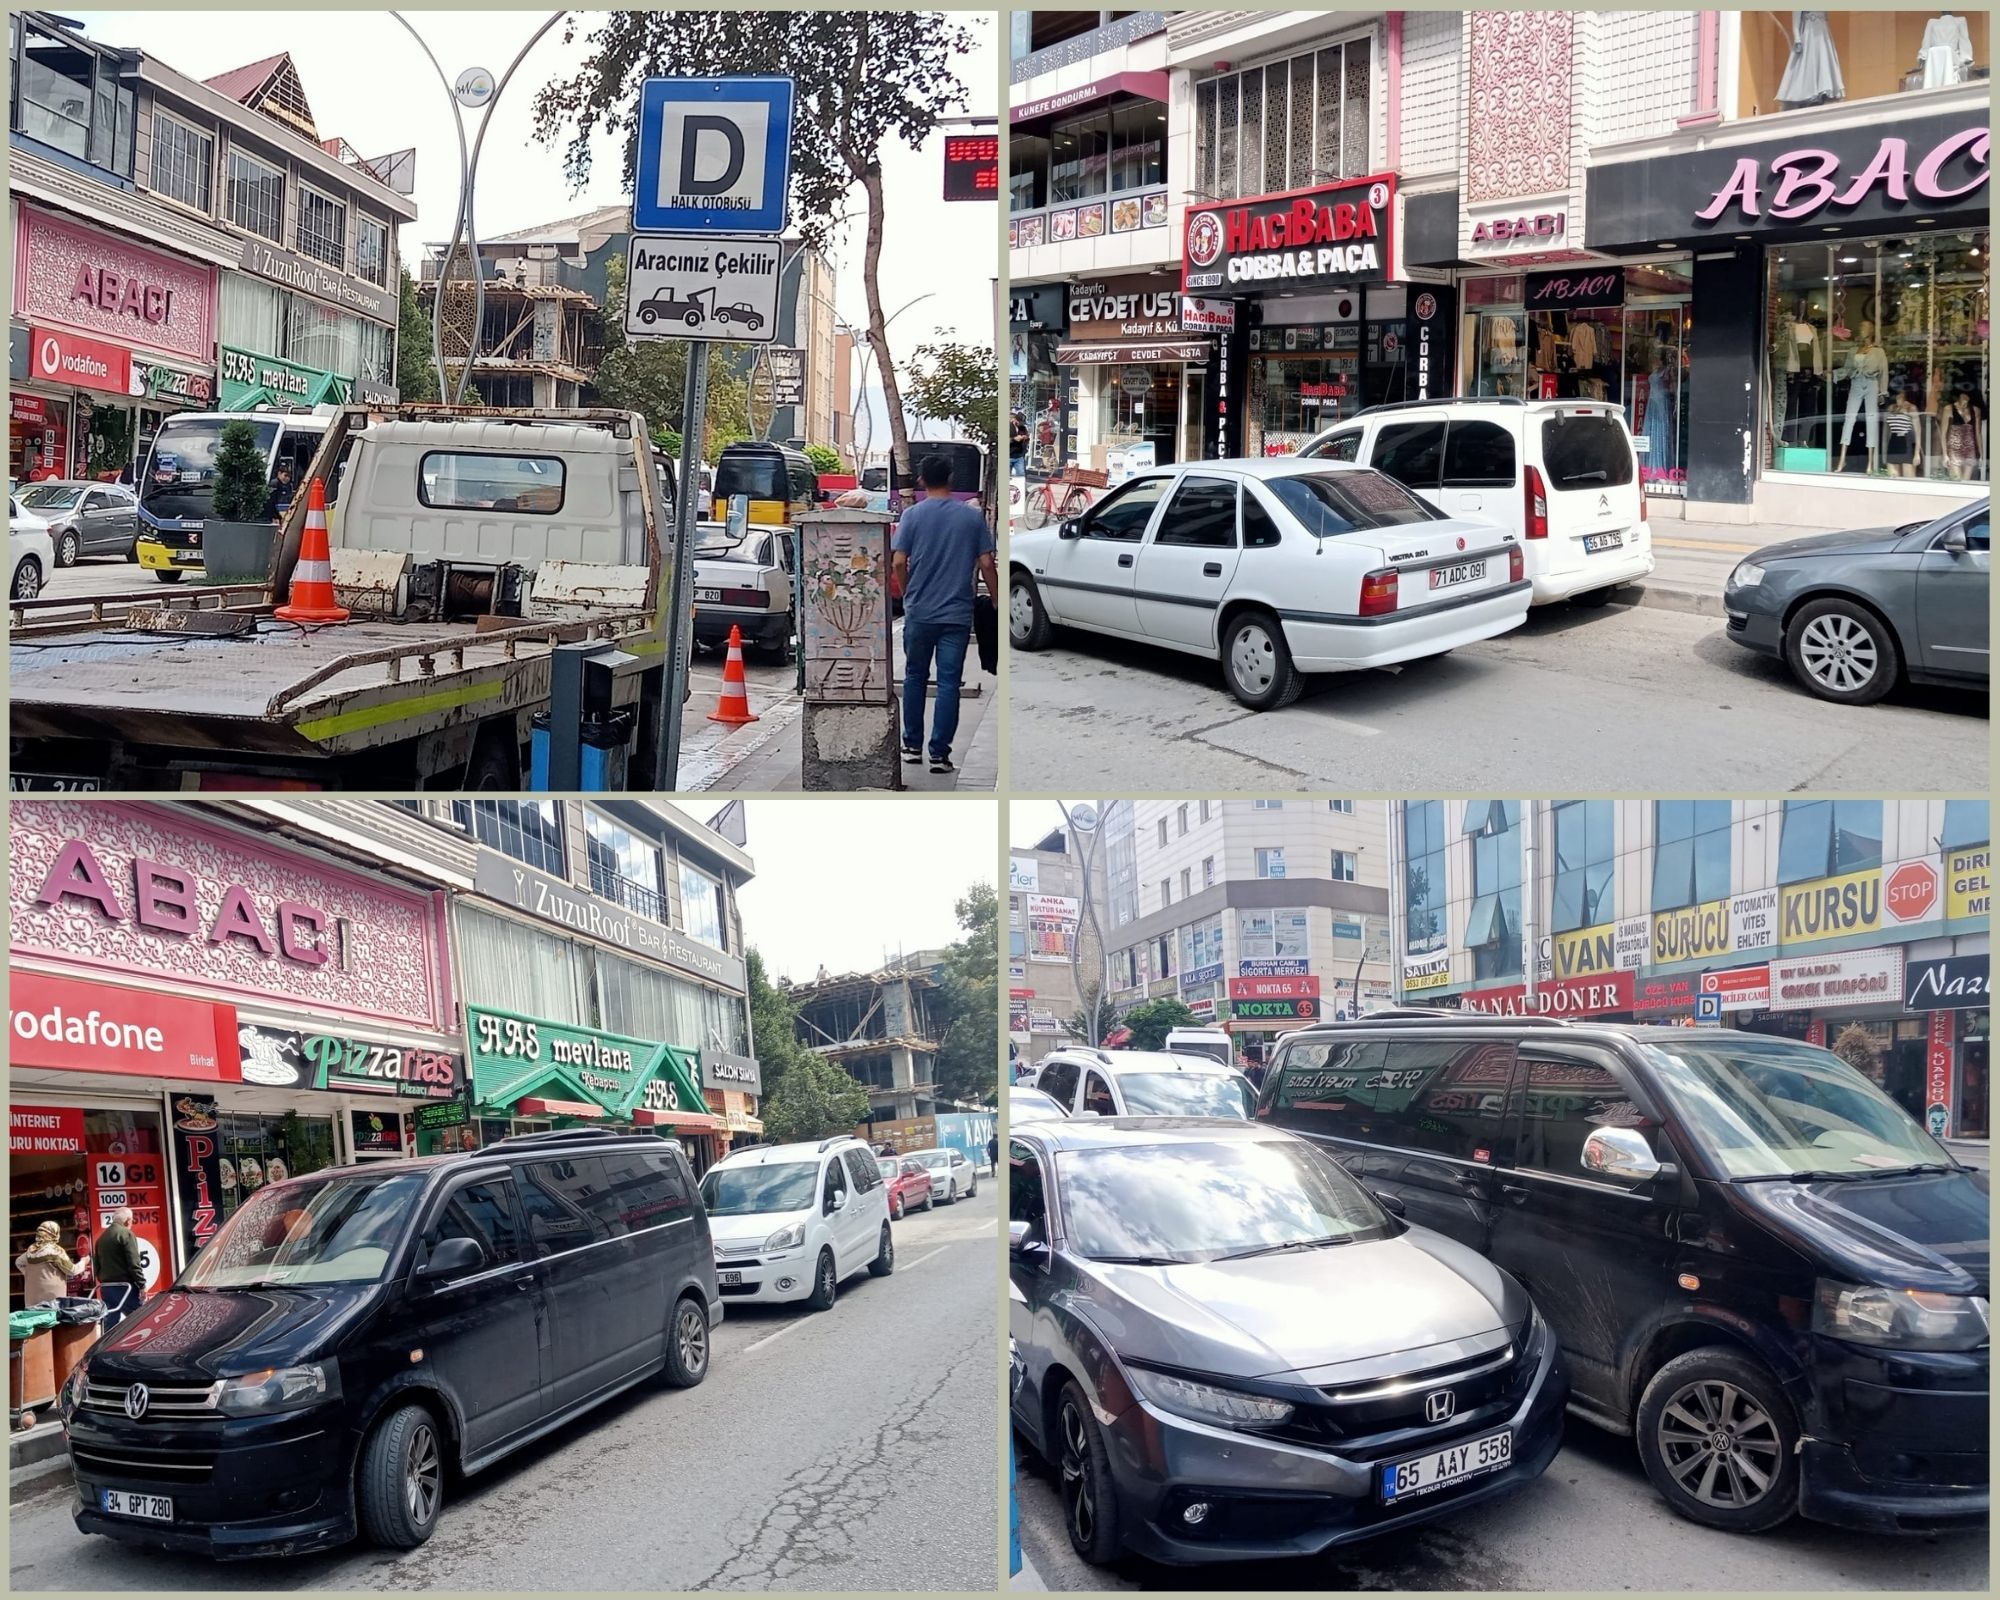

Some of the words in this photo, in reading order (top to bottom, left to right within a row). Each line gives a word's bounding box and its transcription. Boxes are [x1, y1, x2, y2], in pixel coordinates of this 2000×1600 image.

[1051, 86, 1097, 109] DONDURMA
[679, 115, 745, 195] D
[671, 196, 700, 209] HALK
[702, 196, 752, 210] OTOBÜSÜ
[1373, 187, 1382, 204] 3
[1471, 212, 1565, 242] ABACI
[634, 248, 709, 273] Aracınız
[715, 251, 775, 278] Çekilir
[1298, 250, 1316, 276] &
[1317, 243, 1379, 274] PAÇA
[1205, 274, 1220, 285] 1990
[1534, 274, 1616, 300] ABACI
[71, 263, 174, 325] ABACI
[1068, 295, 1138, 322] CEVDET
[1143, 290, 1182, 318] UST
[1155, 322, 1164, 334] &
[62, 353, 108, 377] vodafone
[1131, 350, 1162, 360] CEVDET
[1180, 348, 1201, 358] USTA
[262, 367, 308, 394] mevlana
[1388, 552, 1414, 562] VECTRA
[1434, 570, 1447, 587] 71
[1449, 566, 1467, 584] ADC
[1470, 562, 1485, 578] 091
[704, 590, 719, 600] 820
[1040, 896, 1064, 905] ANKA
[1890, 880, 1932, 903] STOP
[38, 839, 353, 973] ABACI
[1055, 907, 1075, 916] SANAT
[1785, 878, 1880, 938] KURSU
[1657, 900, 1729, 958] SÜRÜCÜ
[668, 939, 724, 977] RESTAURANT
[1558, 933, 1615, 976] VAN
[1240, 966, 1273, 977] SİGORTA
[1274, 965, 1307, 976] MERKEZİ
[1406, 960, 1448, 977] SATILIK
[1256, 983, 1281, 994] NOKTA
[1282, 983, 1292, 994] 65
[1538, 982, 1619, 1014] DÖNER
[1238, 1002, 1293, 1016] NOKTA
[1298, 1004, 1312, 1013] 65
[1702, 1000, 1714, 1015] D
[9, 1006, 164, 1052] odafone
[478, 1014, 541, 1061] HAS
[553, 1036, 633, 1073] mevlana
[190, 1054, 215, 1067] Birhat
[302, 1035, 454, 1090] Pizzarias
[713, 1062, 739, 1081] SALON
[645, 1079, 679, 1110] HAS
[35, 1137, 79, 1151] NOKTASI
[100, 1165, 121, 1183] 16
[126, 1164, 156, 1183] GB
[100, 1194, 126, 1205] 1000
[129, 1193, 149, 1205] DK
[1396, 1462, 1420, 1491] 65
[1436, 1446, 1470, 1479] AAY
[1478, 1434, 1510, 1464] 558
[108, 1492, 121, 1511] 34
[128, 1496, 149, 1514] GPT
[151, 1499, 171, 1518] 280
